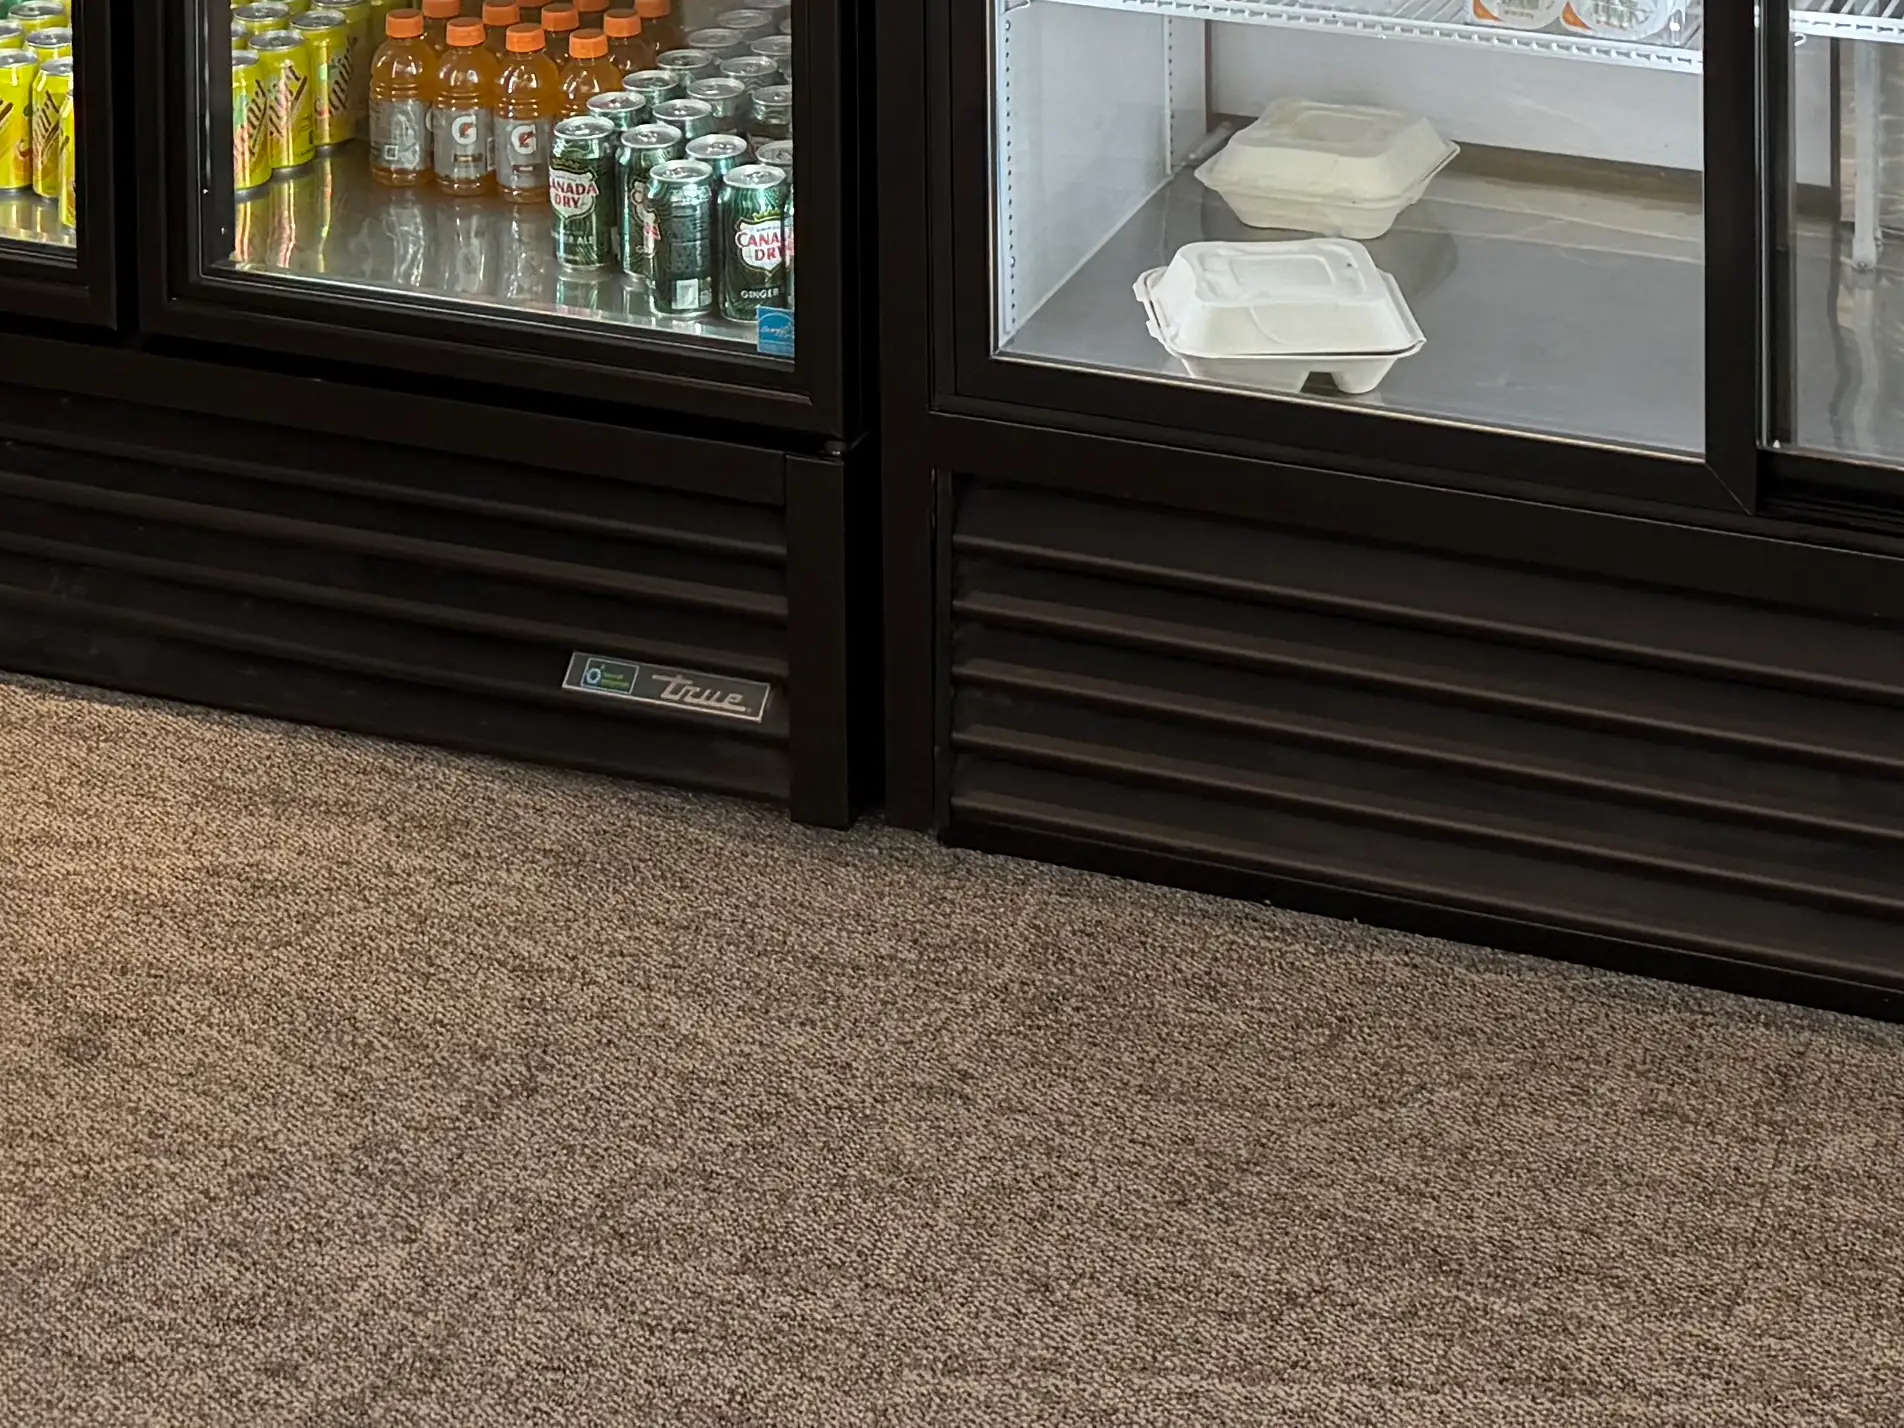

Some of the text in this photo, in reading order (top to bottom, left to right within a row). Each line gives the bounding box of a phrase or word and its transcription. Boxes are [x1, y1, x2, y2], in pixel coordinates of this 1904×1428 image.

[452, 115, 477, 144] G
[511, 123, 536, 155] G
[554, 193, 581, 209] DRY
